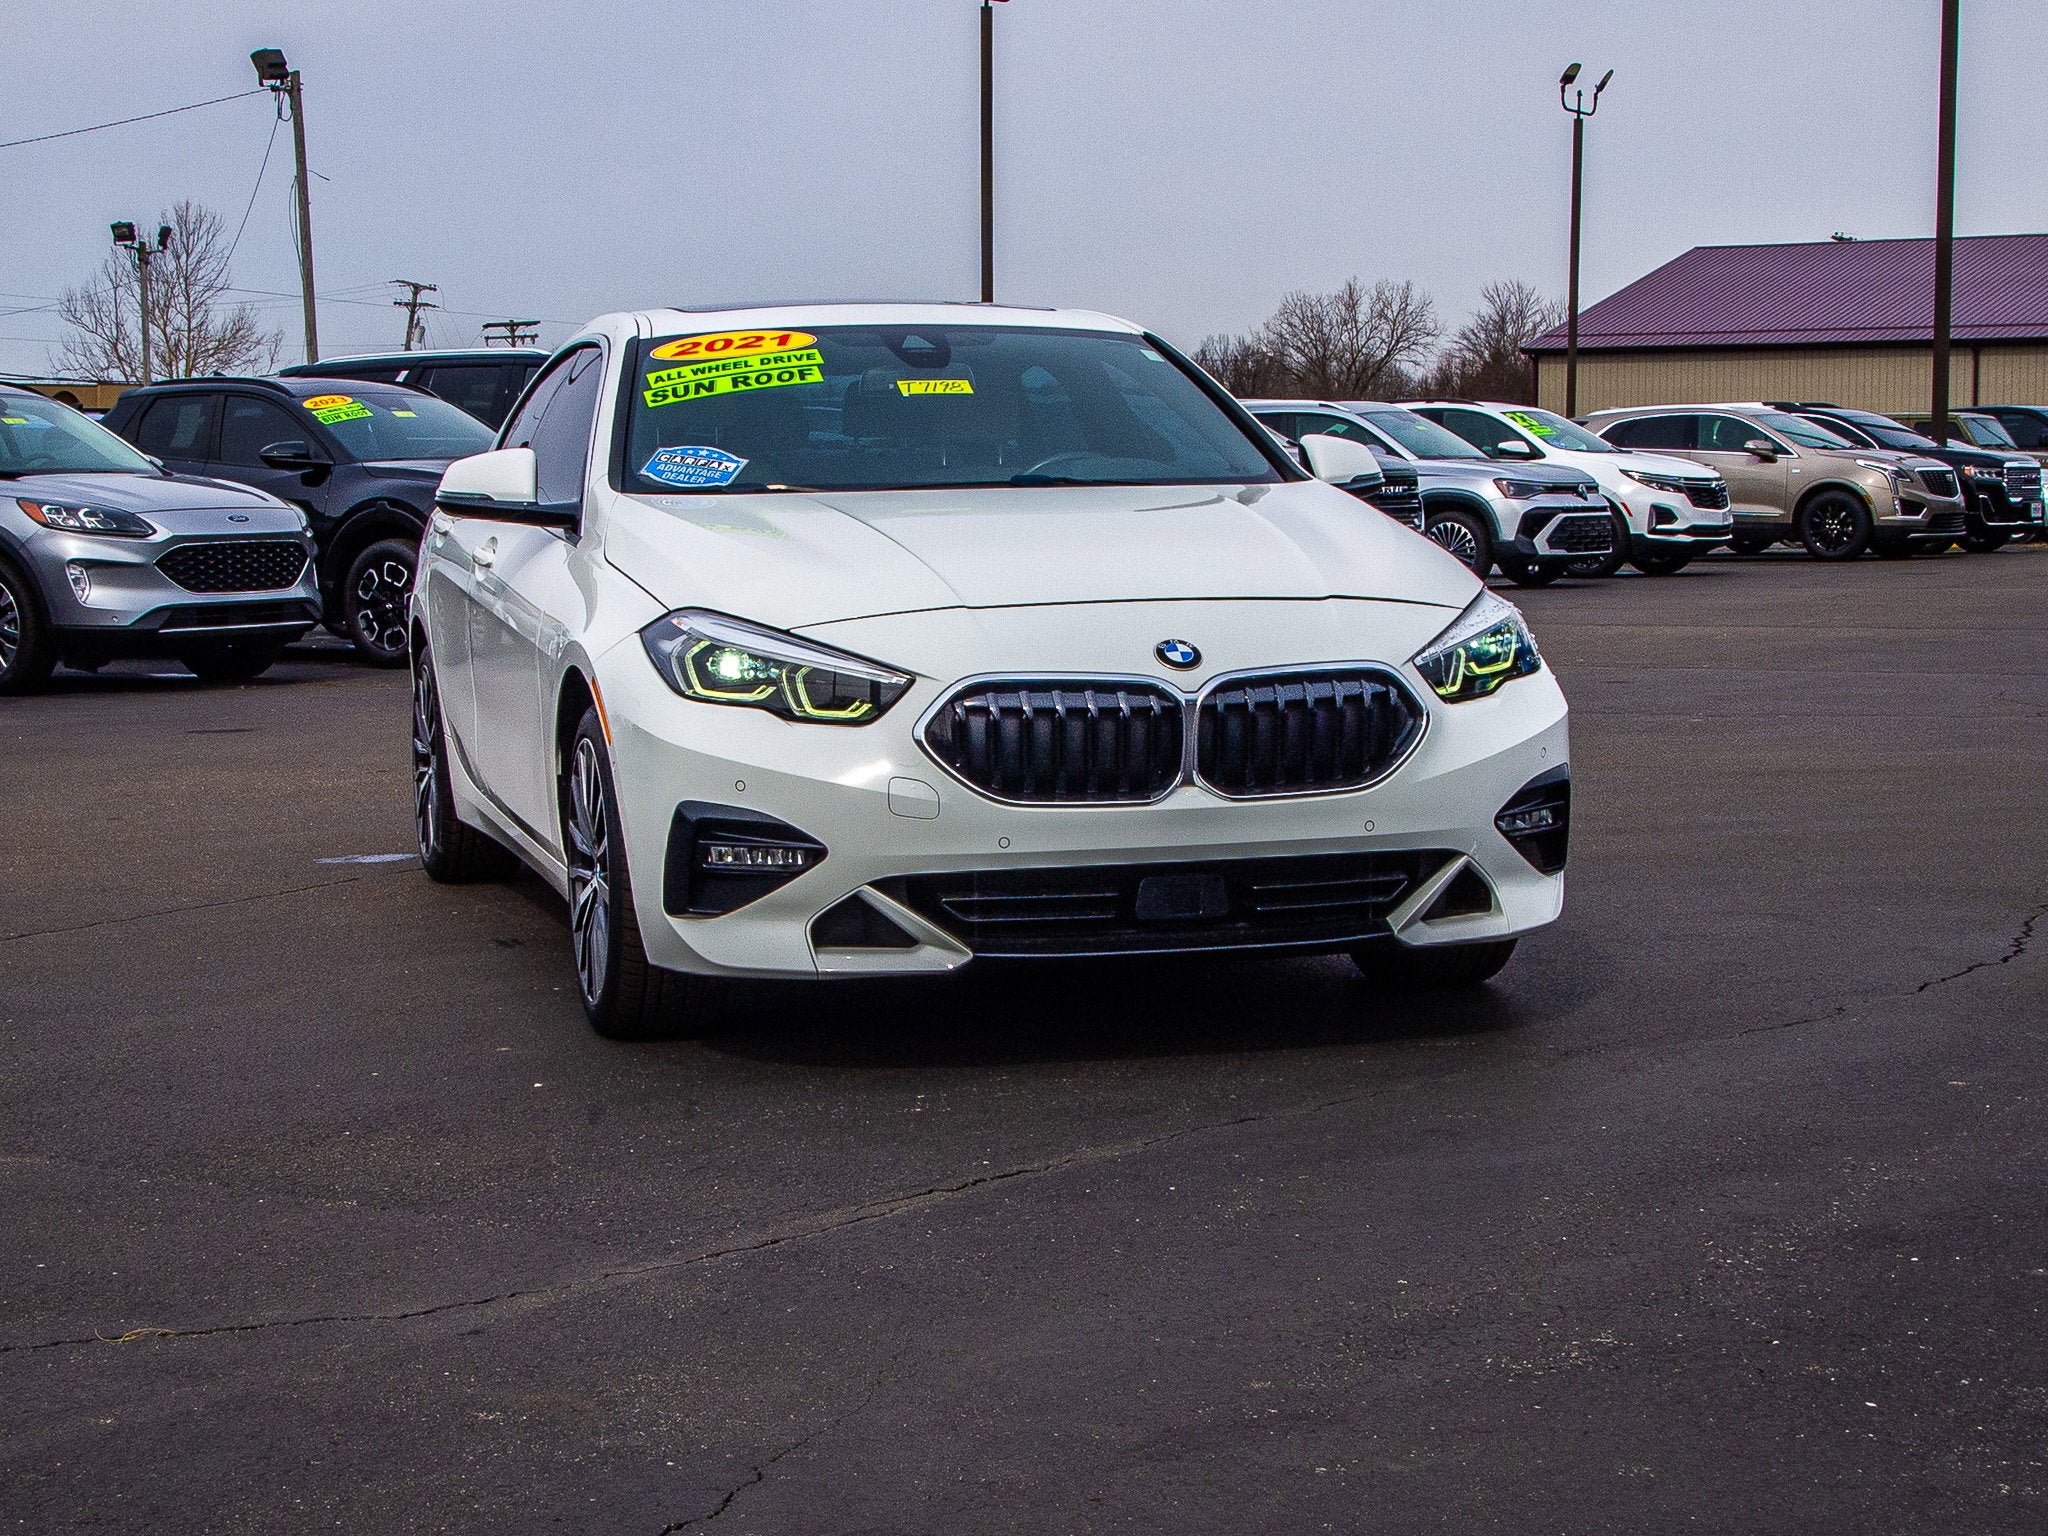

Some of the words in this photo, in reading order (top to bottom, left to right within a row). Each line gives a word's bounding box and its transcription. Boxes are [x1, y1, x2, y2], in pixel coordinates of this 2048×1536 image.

[670, 334, 793, 358] 2021
[653, 370, 688, 384] ALL
[690, 360, 753, 376] WHEEL
[759, 352, 817, 366] DRIVE
[650, 379, 717, 404] SUN
[731, 368, 814, 389] ROOF
[310, 396, 347, 407] 2023
[657, 453, 737, 471] CARFAX
[657, 463, 721, 478] ADVANTAGE
[662, 472, 706, 484] DEALER
